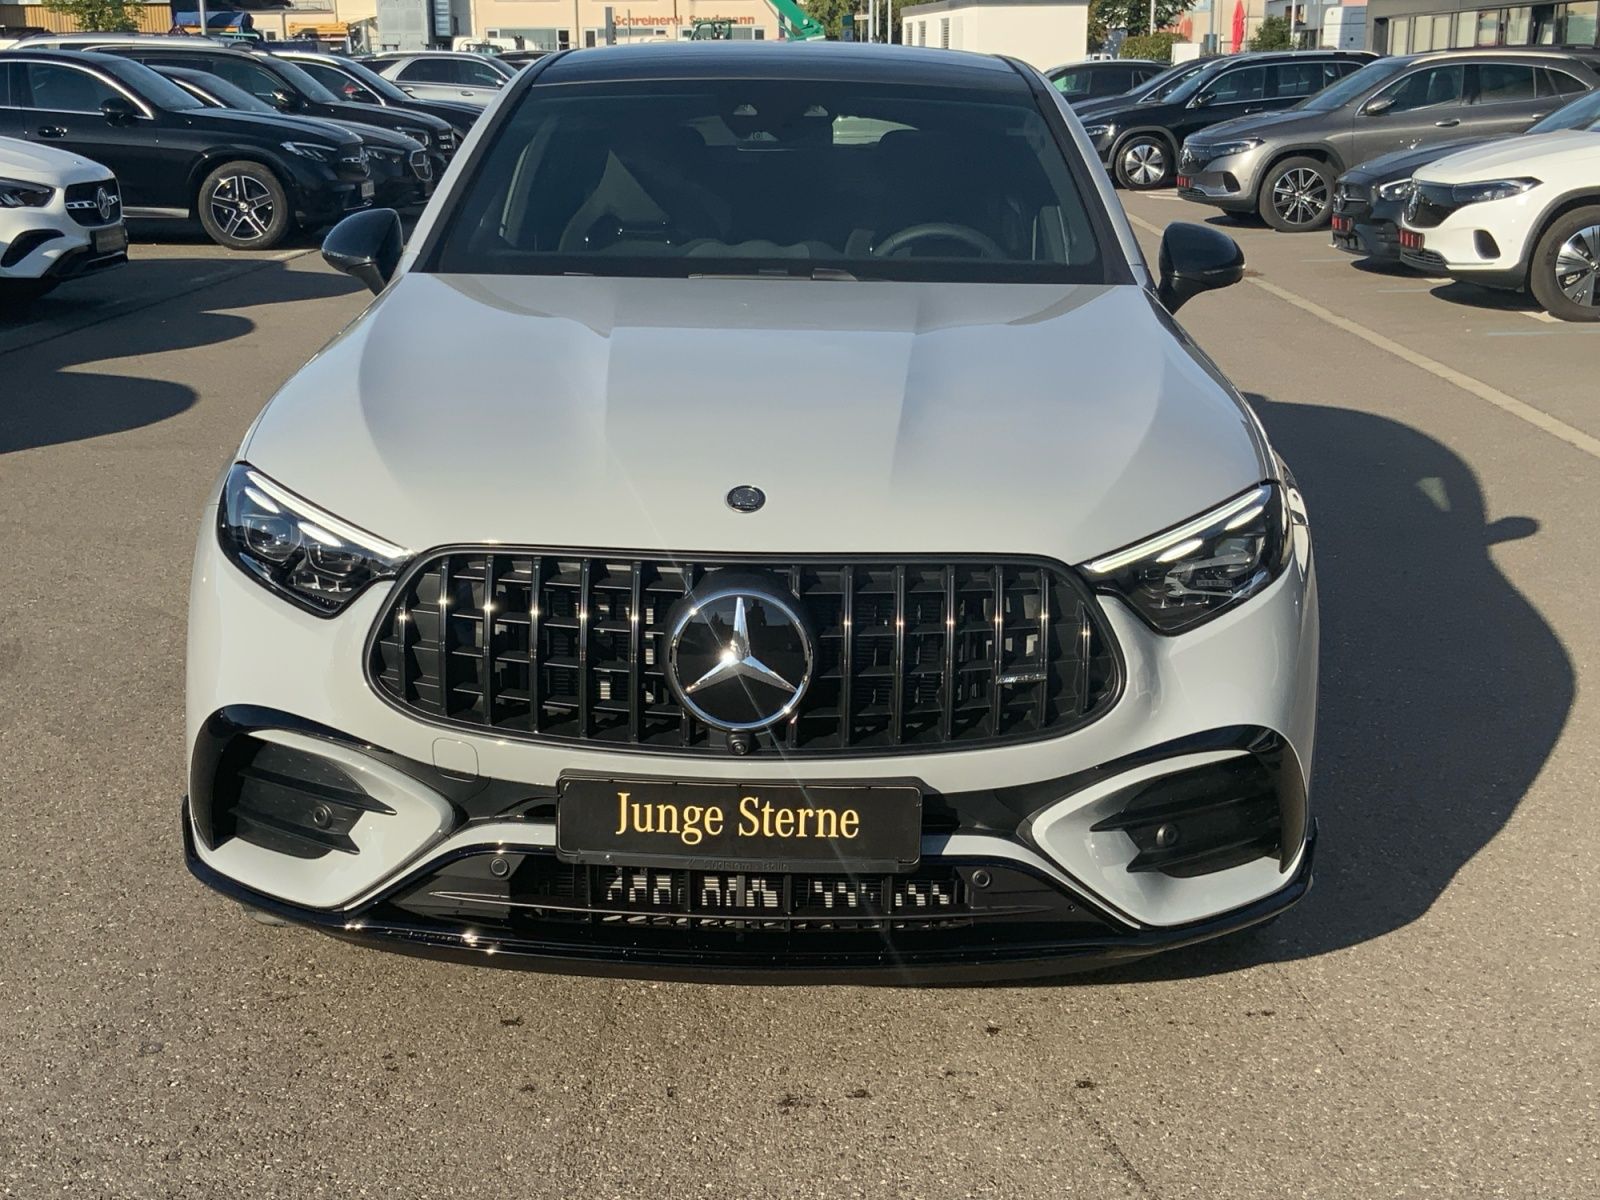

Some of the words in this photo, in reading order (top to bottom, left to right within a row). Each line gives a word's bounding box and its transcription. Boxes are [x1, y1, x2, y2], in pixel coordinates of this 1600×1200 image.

[615, 15, 683, 26] Schreinerei
[615, 792, 724, 845] Junge
[738, 796, 860, 839] Sterne
